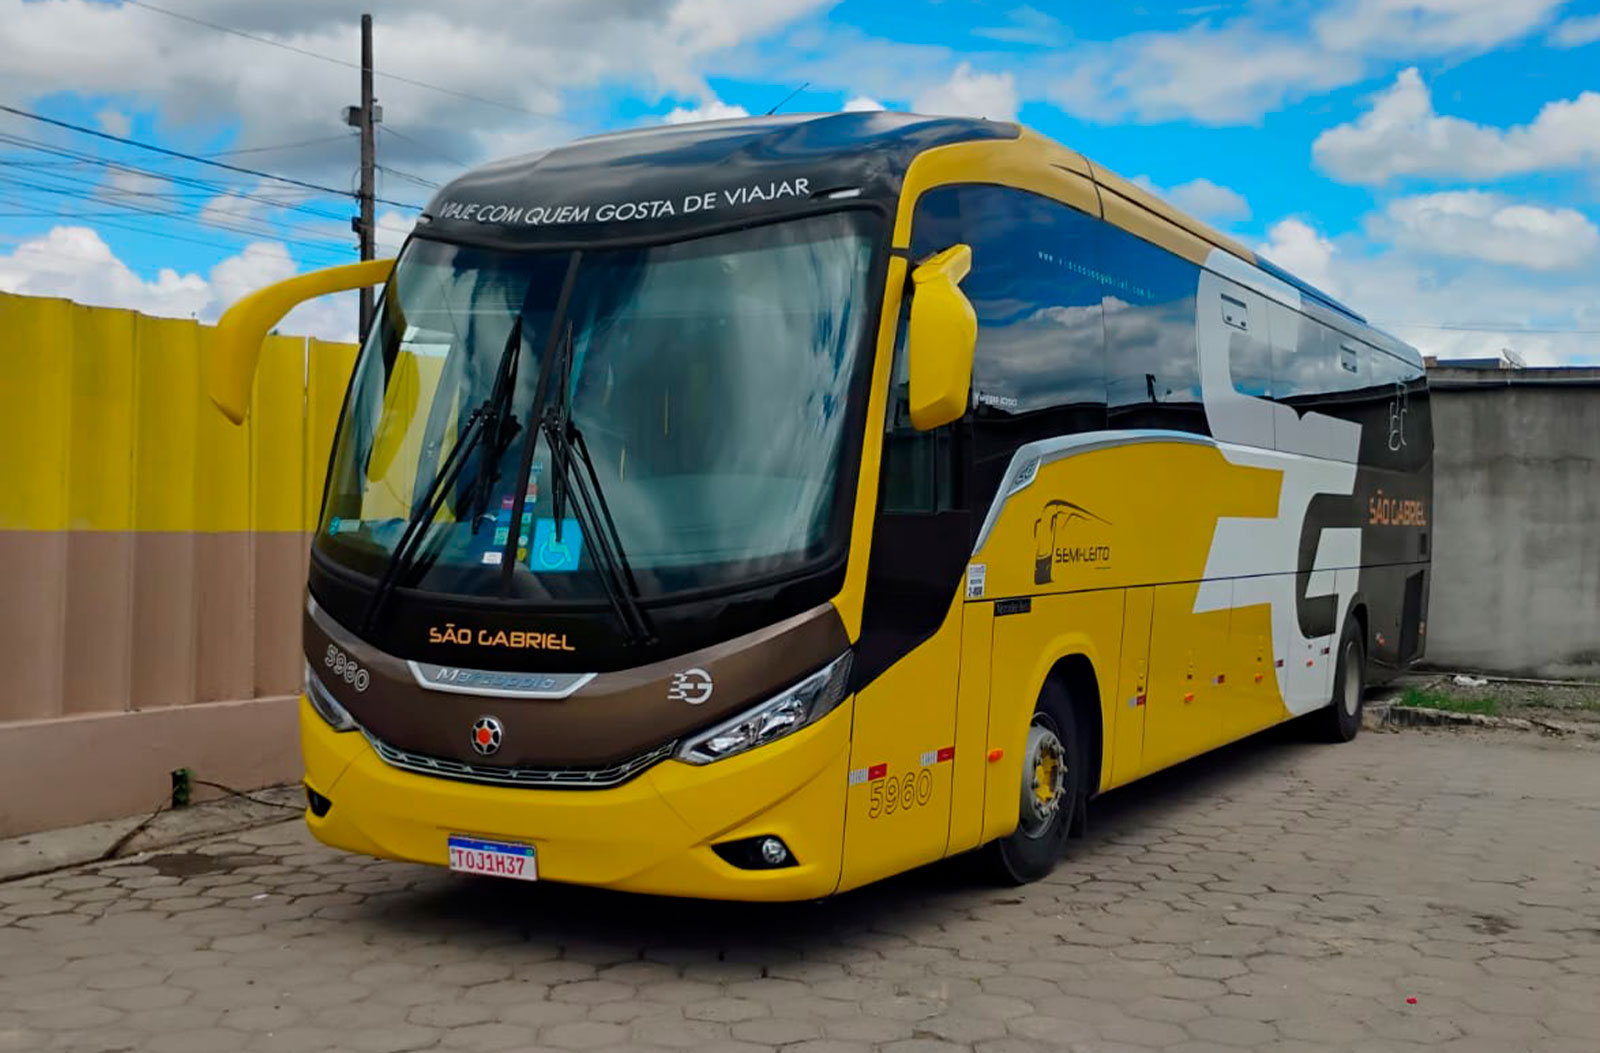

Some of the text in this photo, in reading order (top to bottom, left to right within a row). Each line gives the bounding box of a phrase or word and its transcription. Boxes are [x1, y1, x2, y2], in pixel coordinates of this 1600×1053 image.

[476, 204, 523, 224] COM
[524, 206, 590, 225] QUEM
[595, 200, 675, 222] GOSTA
[683, 192, 717, 213] DE
[724, 178, 810, 206] VIAJAR
[429, 624, 576, 651] SÃO GABRIEL
[325, 644, 370, 693] 5960
[868, 768, 932, 819] 5960
[456, 849, 525, 875] TOJ1H37
